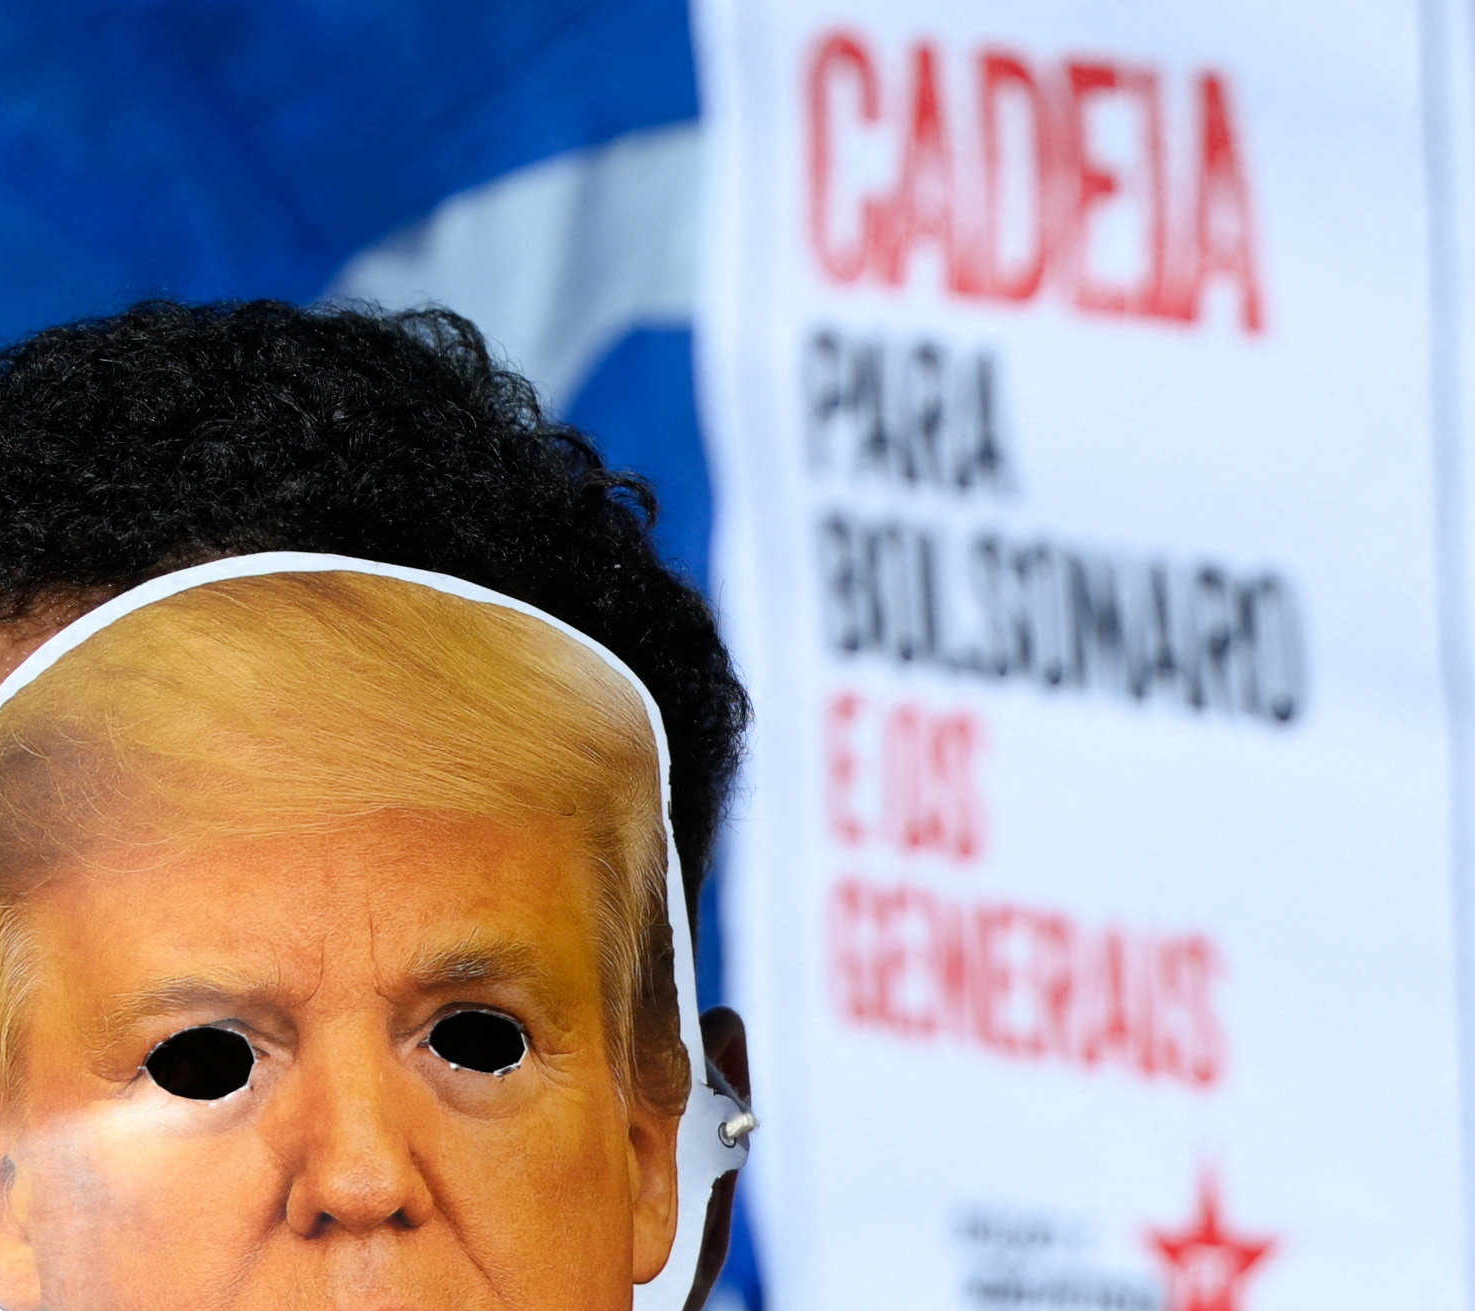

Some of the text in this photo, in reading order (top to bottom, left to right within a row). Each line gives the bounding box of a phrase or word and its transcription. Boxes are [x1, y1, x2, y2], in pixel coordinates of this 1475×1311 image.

[802, 28, 1269, 340] CADEIA
[805, 330, 1015, 494] PARA
[818, 514, 1309, 724] BOLSONARO
[827, 692, 983, 864] E OS
[830, 880, 1225, 1088] GENERAIS
